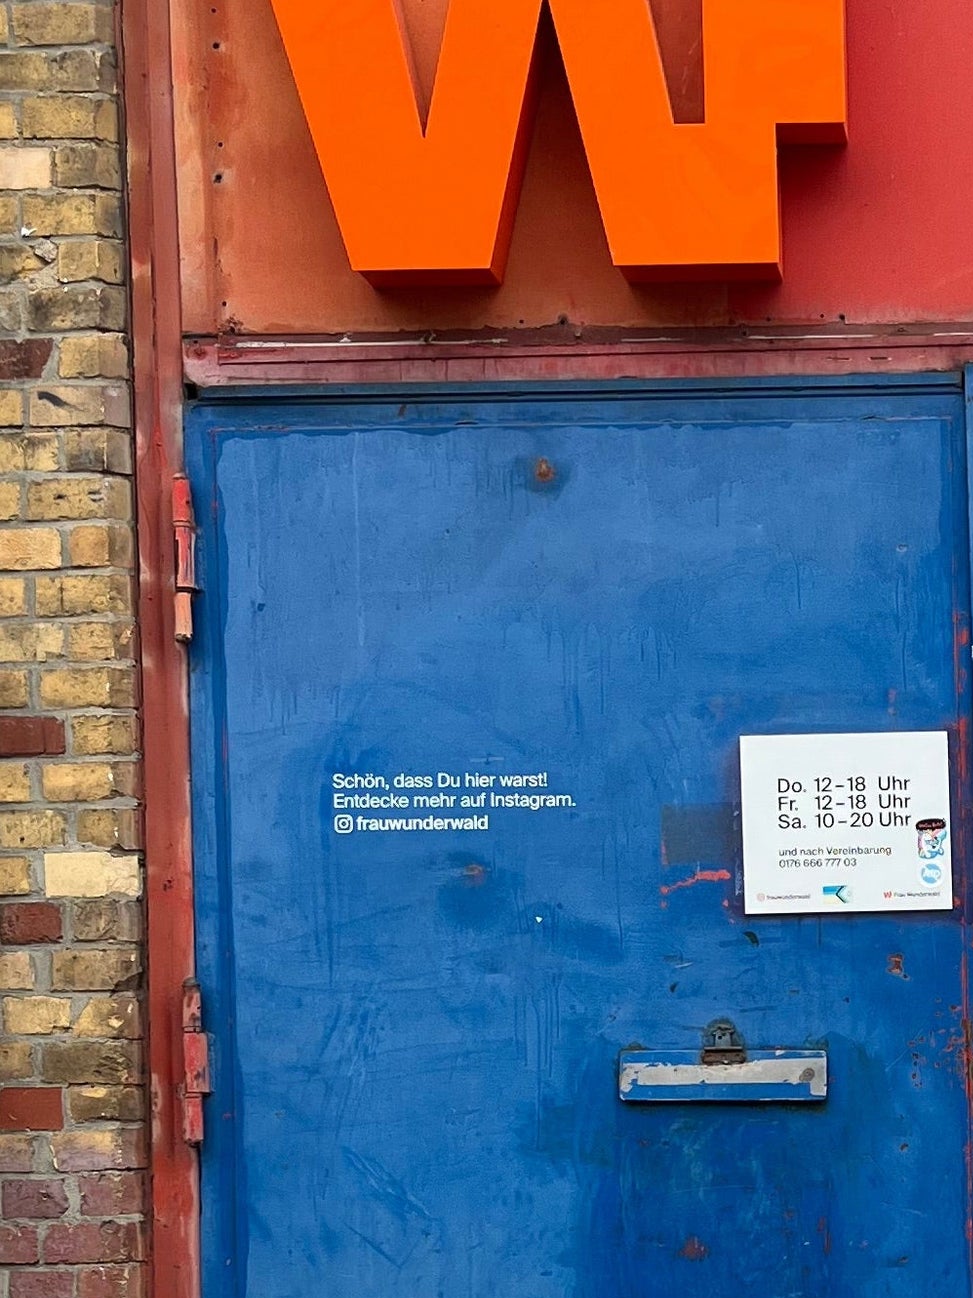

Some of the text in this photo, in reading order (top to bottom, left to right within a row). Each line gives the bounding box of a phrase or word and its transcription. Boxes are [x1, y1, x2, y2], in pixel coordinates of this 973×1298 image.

[332, 772, 548, 791] Schön, dass Du hier warst!
[777, 777, 807, 793] Do.
[878, 775, 911, 791] Uhr
[333, 792, 577, 810] Entdecke mehr auf Instagram.
[778, 796, 799, 811] Fr.
[878, 793, 911, 809] Uhr
[356, 814, 489, 831] frauwunderwald
[778, 814, 807, 829] Sa.
[879, 811, 912, 827] Uhr
[778, 846, 892, 857] und nach Vereinbarung
[778, 858, 857, 868] 0176 666 777 03
